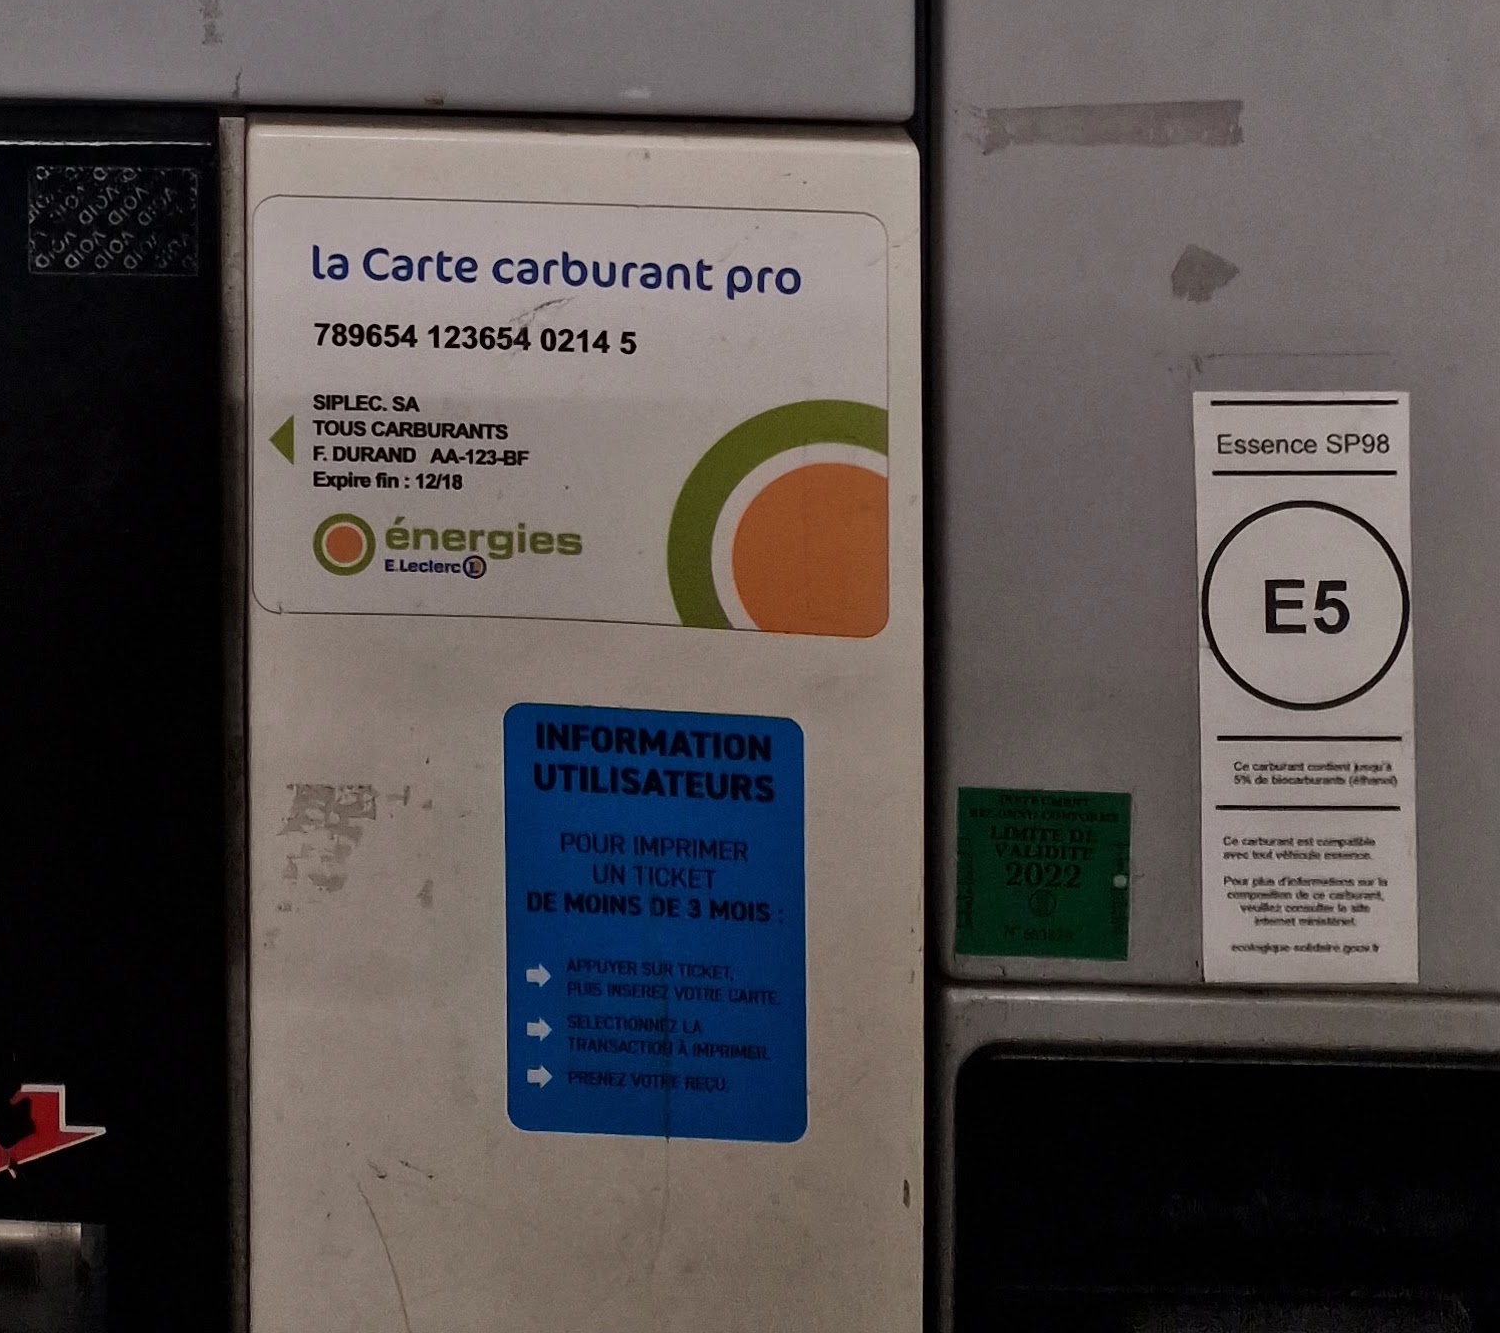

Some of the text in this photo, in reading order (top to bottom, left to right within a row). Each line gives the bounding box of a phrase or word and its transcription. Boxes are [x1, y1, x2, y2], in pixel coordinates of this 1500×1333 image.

[311, 245, 802, 300] la Carte carburant pro
[313, 323, 637, 355] 789654 123654 0214 5
[312, 394, 420, 413] SIPLEC. SA
[312, 419, 509, 440] TOUS CARBURANTS
[312, 445, 530, 467] F. DURAND AA-123-BF
[1216, 433, 1391, 455] Essence SP98
[312, 471, 371, 494] Expire
[375, 471, 401, 490] fin
[415, 472, 463, 492] 12/18
[385, 517, 583, 560] énergies
[385, 559, 461, 575] E.Leclerc
[1264, 578, 1351, 635] E5
[535, 722, 772, 763] INFORMATION
[533, 762, 775, 804] UTILISATEURS
[560, 833, 749, 862] POUR IMPRIMER
[592, 864, 717, 890] UN TICKET
[1005, 862, 1082, 888] 2022
[526, 891, 771, 922] DE MOINS DE 3 MOIS
